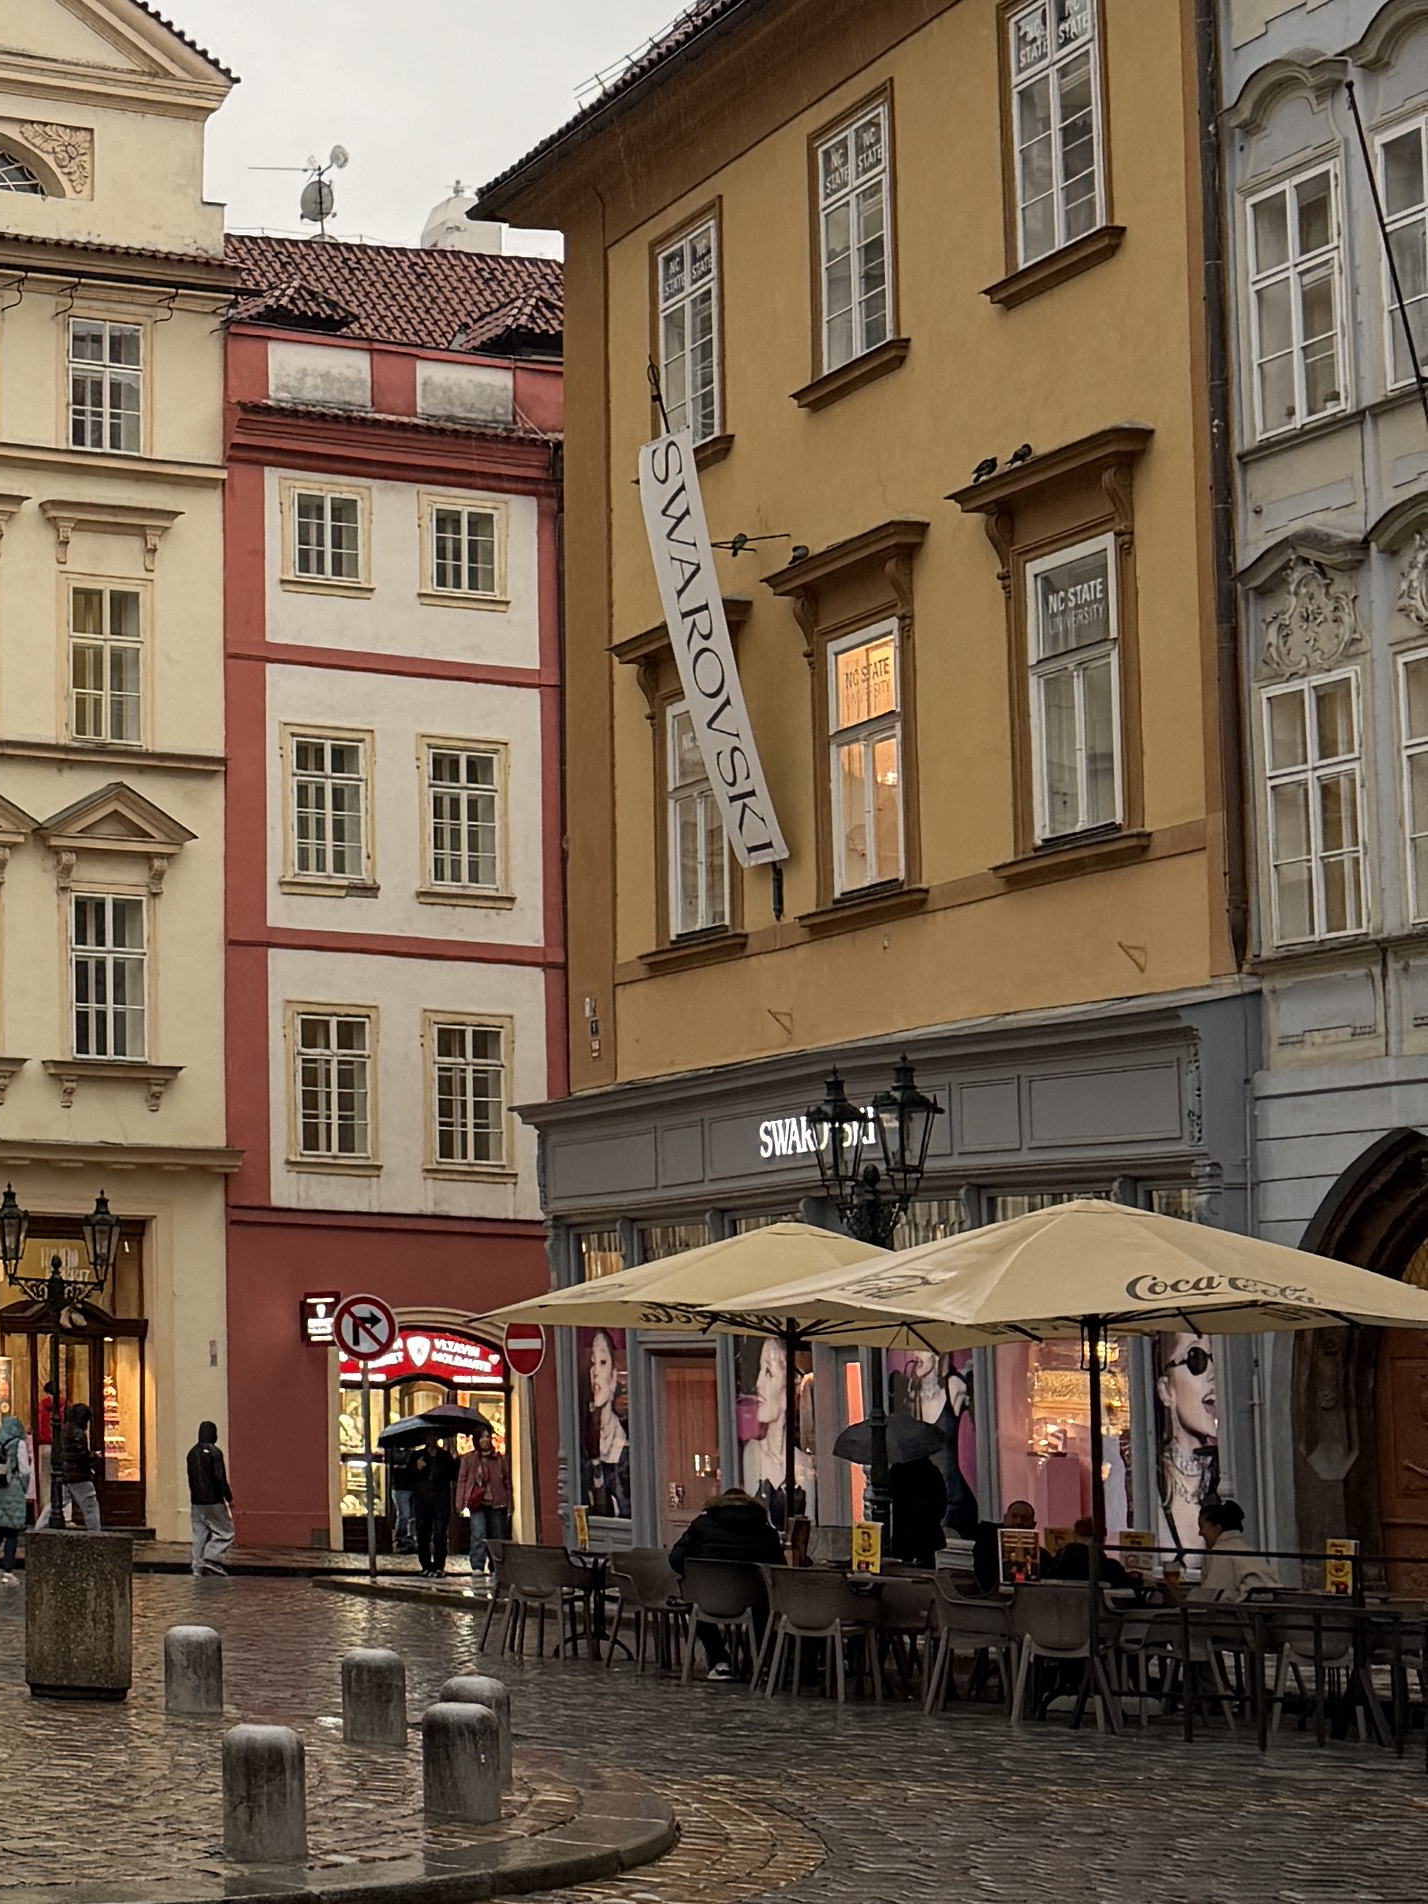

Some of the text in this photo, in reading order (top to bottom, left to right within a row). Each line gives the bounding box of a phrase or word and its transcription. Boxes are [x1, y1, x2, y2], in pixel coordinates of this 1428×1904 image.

[1048, 578, 1103, 614] NC STATE
[651, 440, 774, 853] SWAROVSKI
[844, 657, 890, 689] NC STATE
